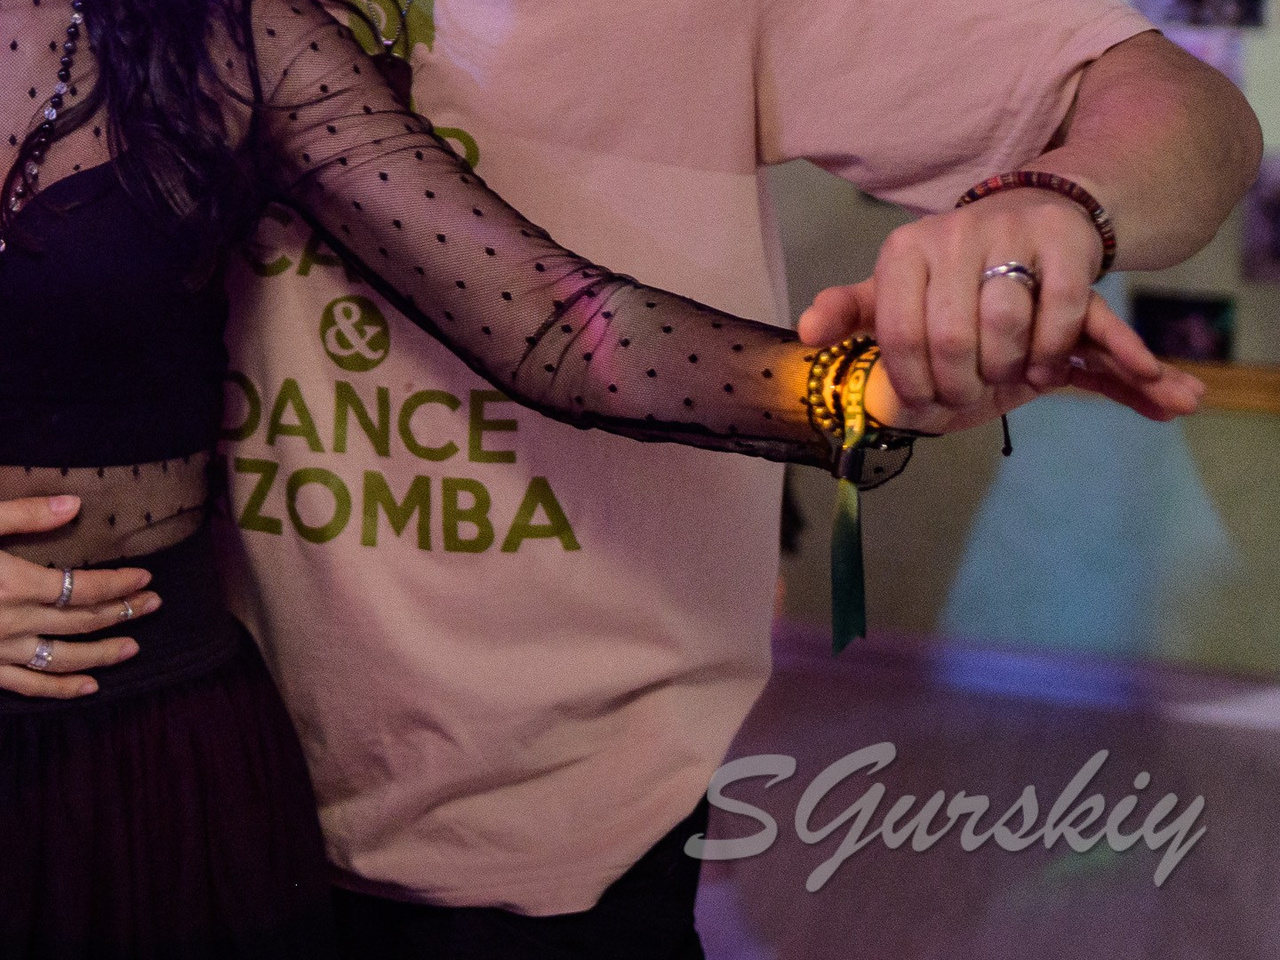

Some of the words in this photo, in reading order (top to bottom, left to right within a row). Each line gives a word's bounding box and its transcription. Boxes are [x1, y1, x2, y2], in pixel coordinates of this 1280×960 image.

[324, 302, 383, 367] &
[219, 371, 519, 464] DANCE
[233, 457, 582, 554] ZOMBA
